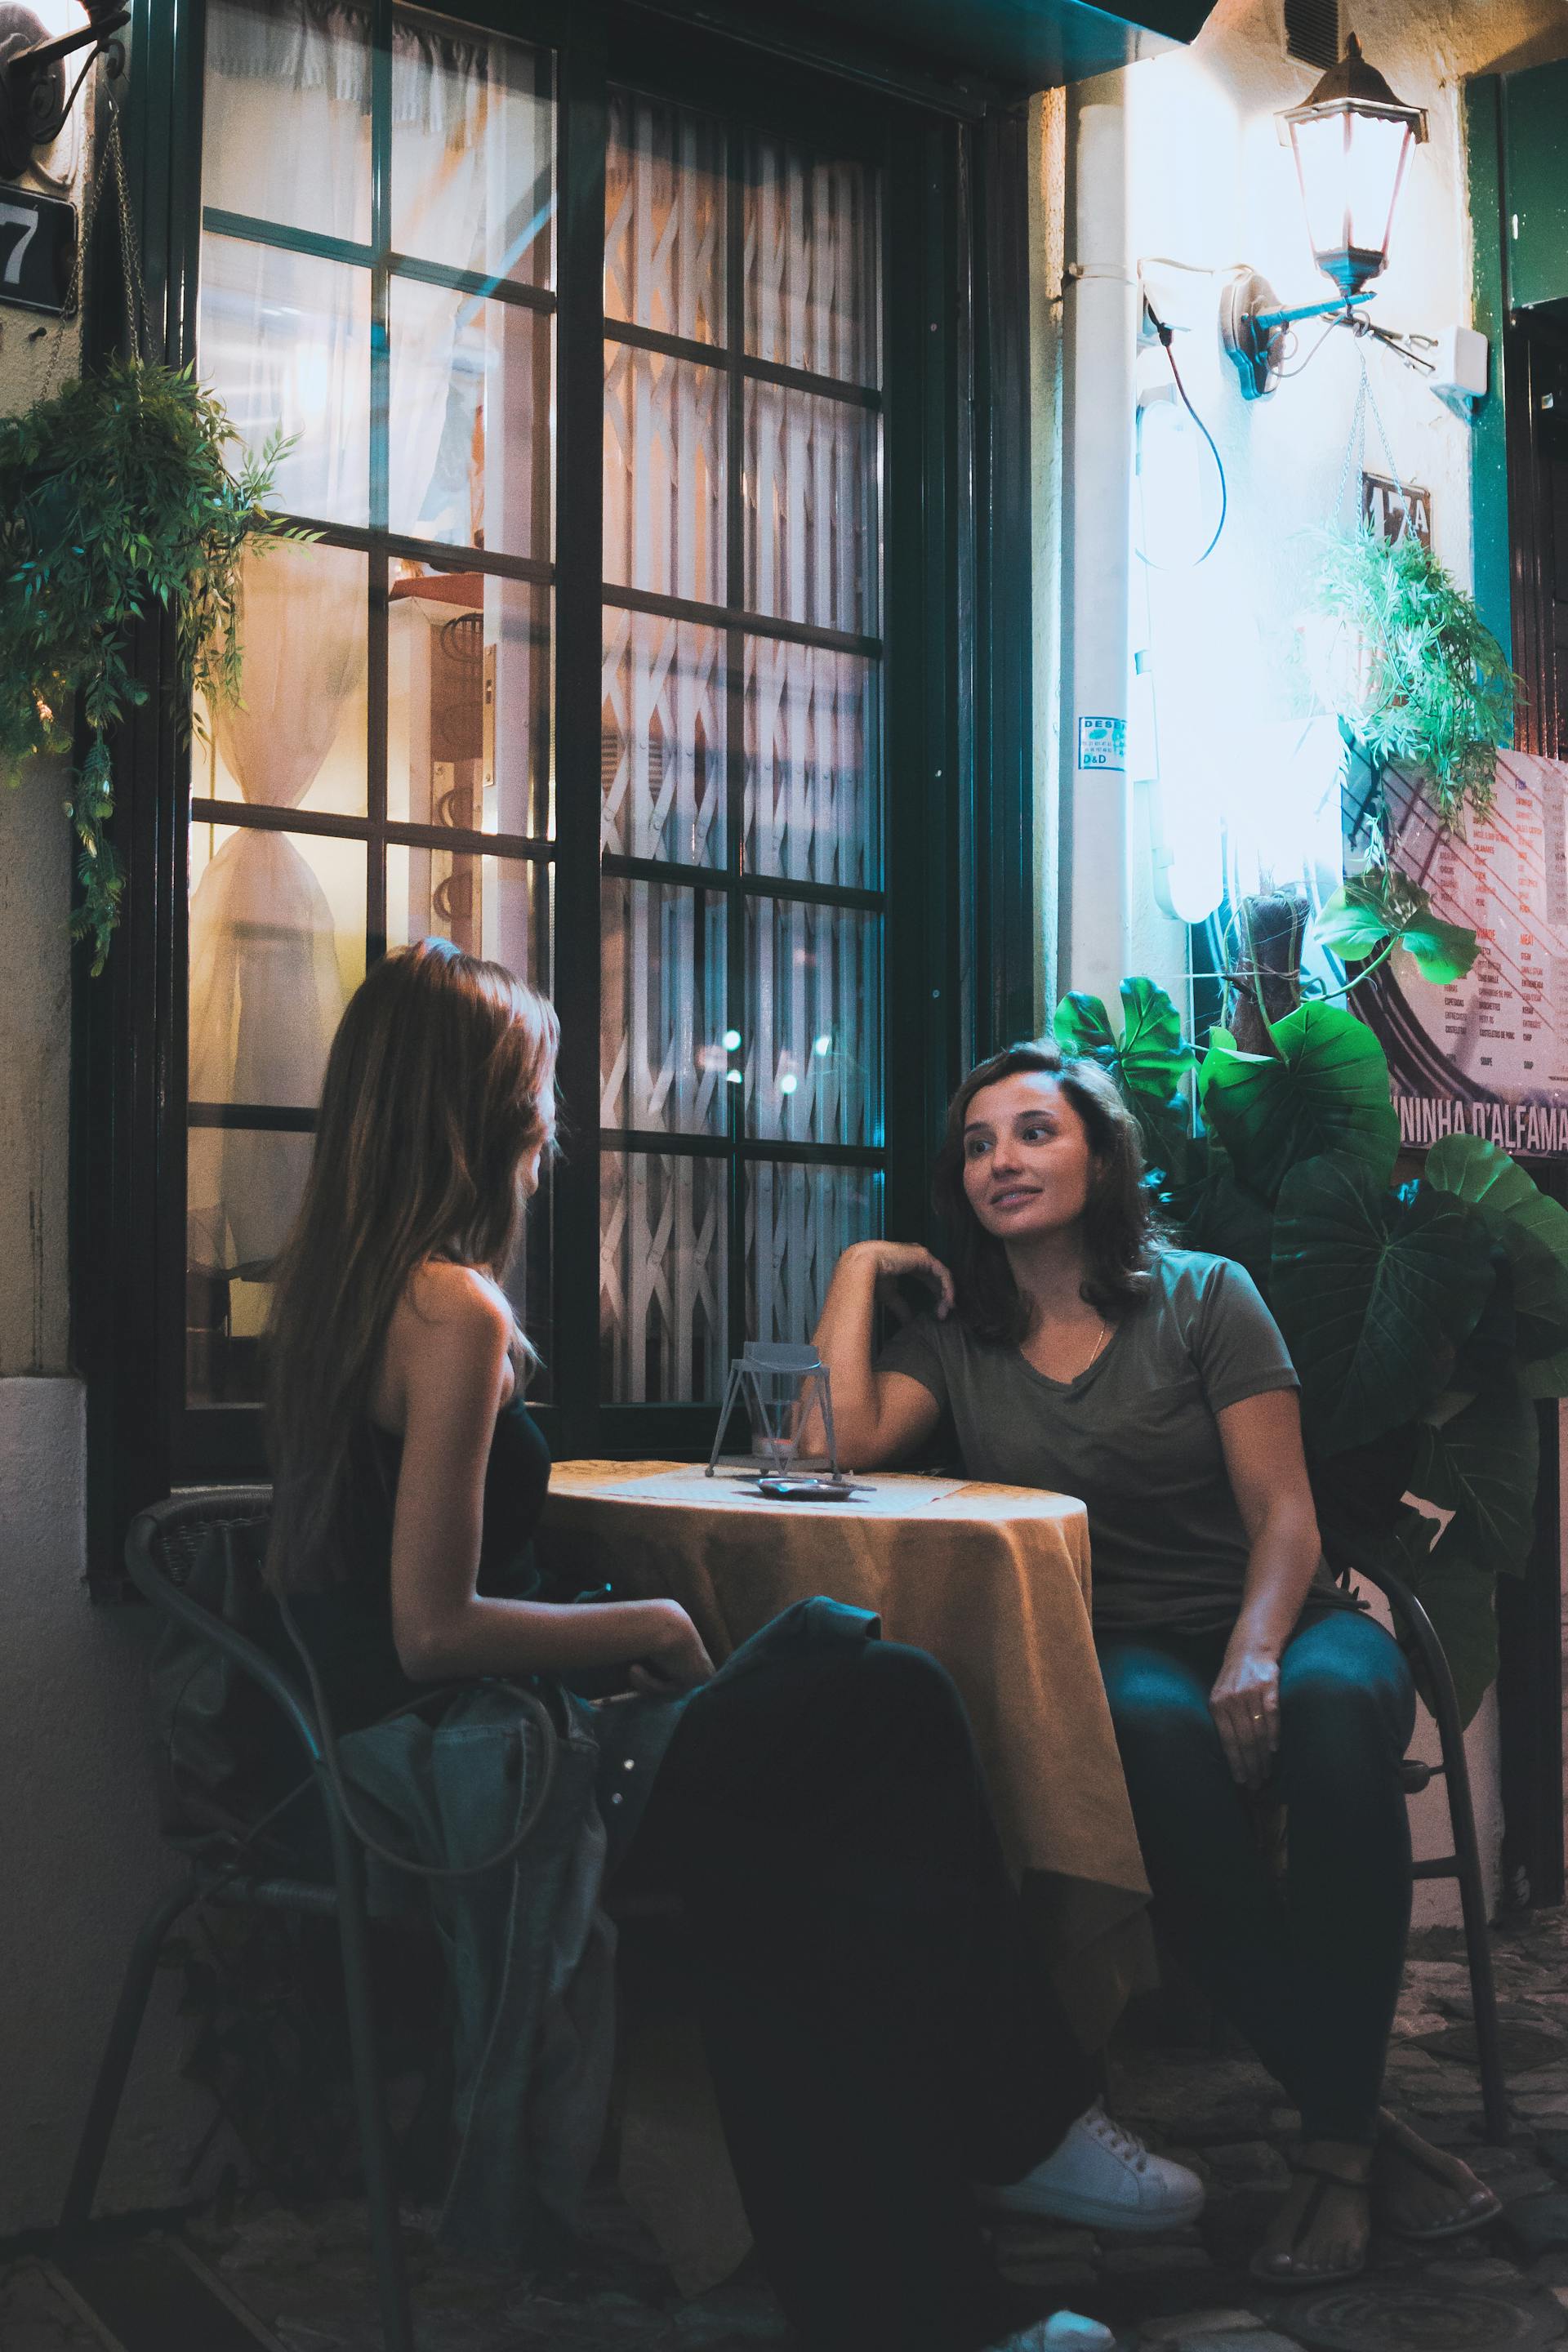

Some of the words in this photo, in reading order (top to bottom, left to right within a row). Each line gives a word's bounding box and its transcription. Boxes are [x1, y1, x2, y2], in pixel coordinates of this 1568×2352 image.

[1084, 754, 1107, 764] D&D
[1389, 1095, 1466, 1143] NINHA
[1472, 1102, 1568, 1151] D'ALFAMA
